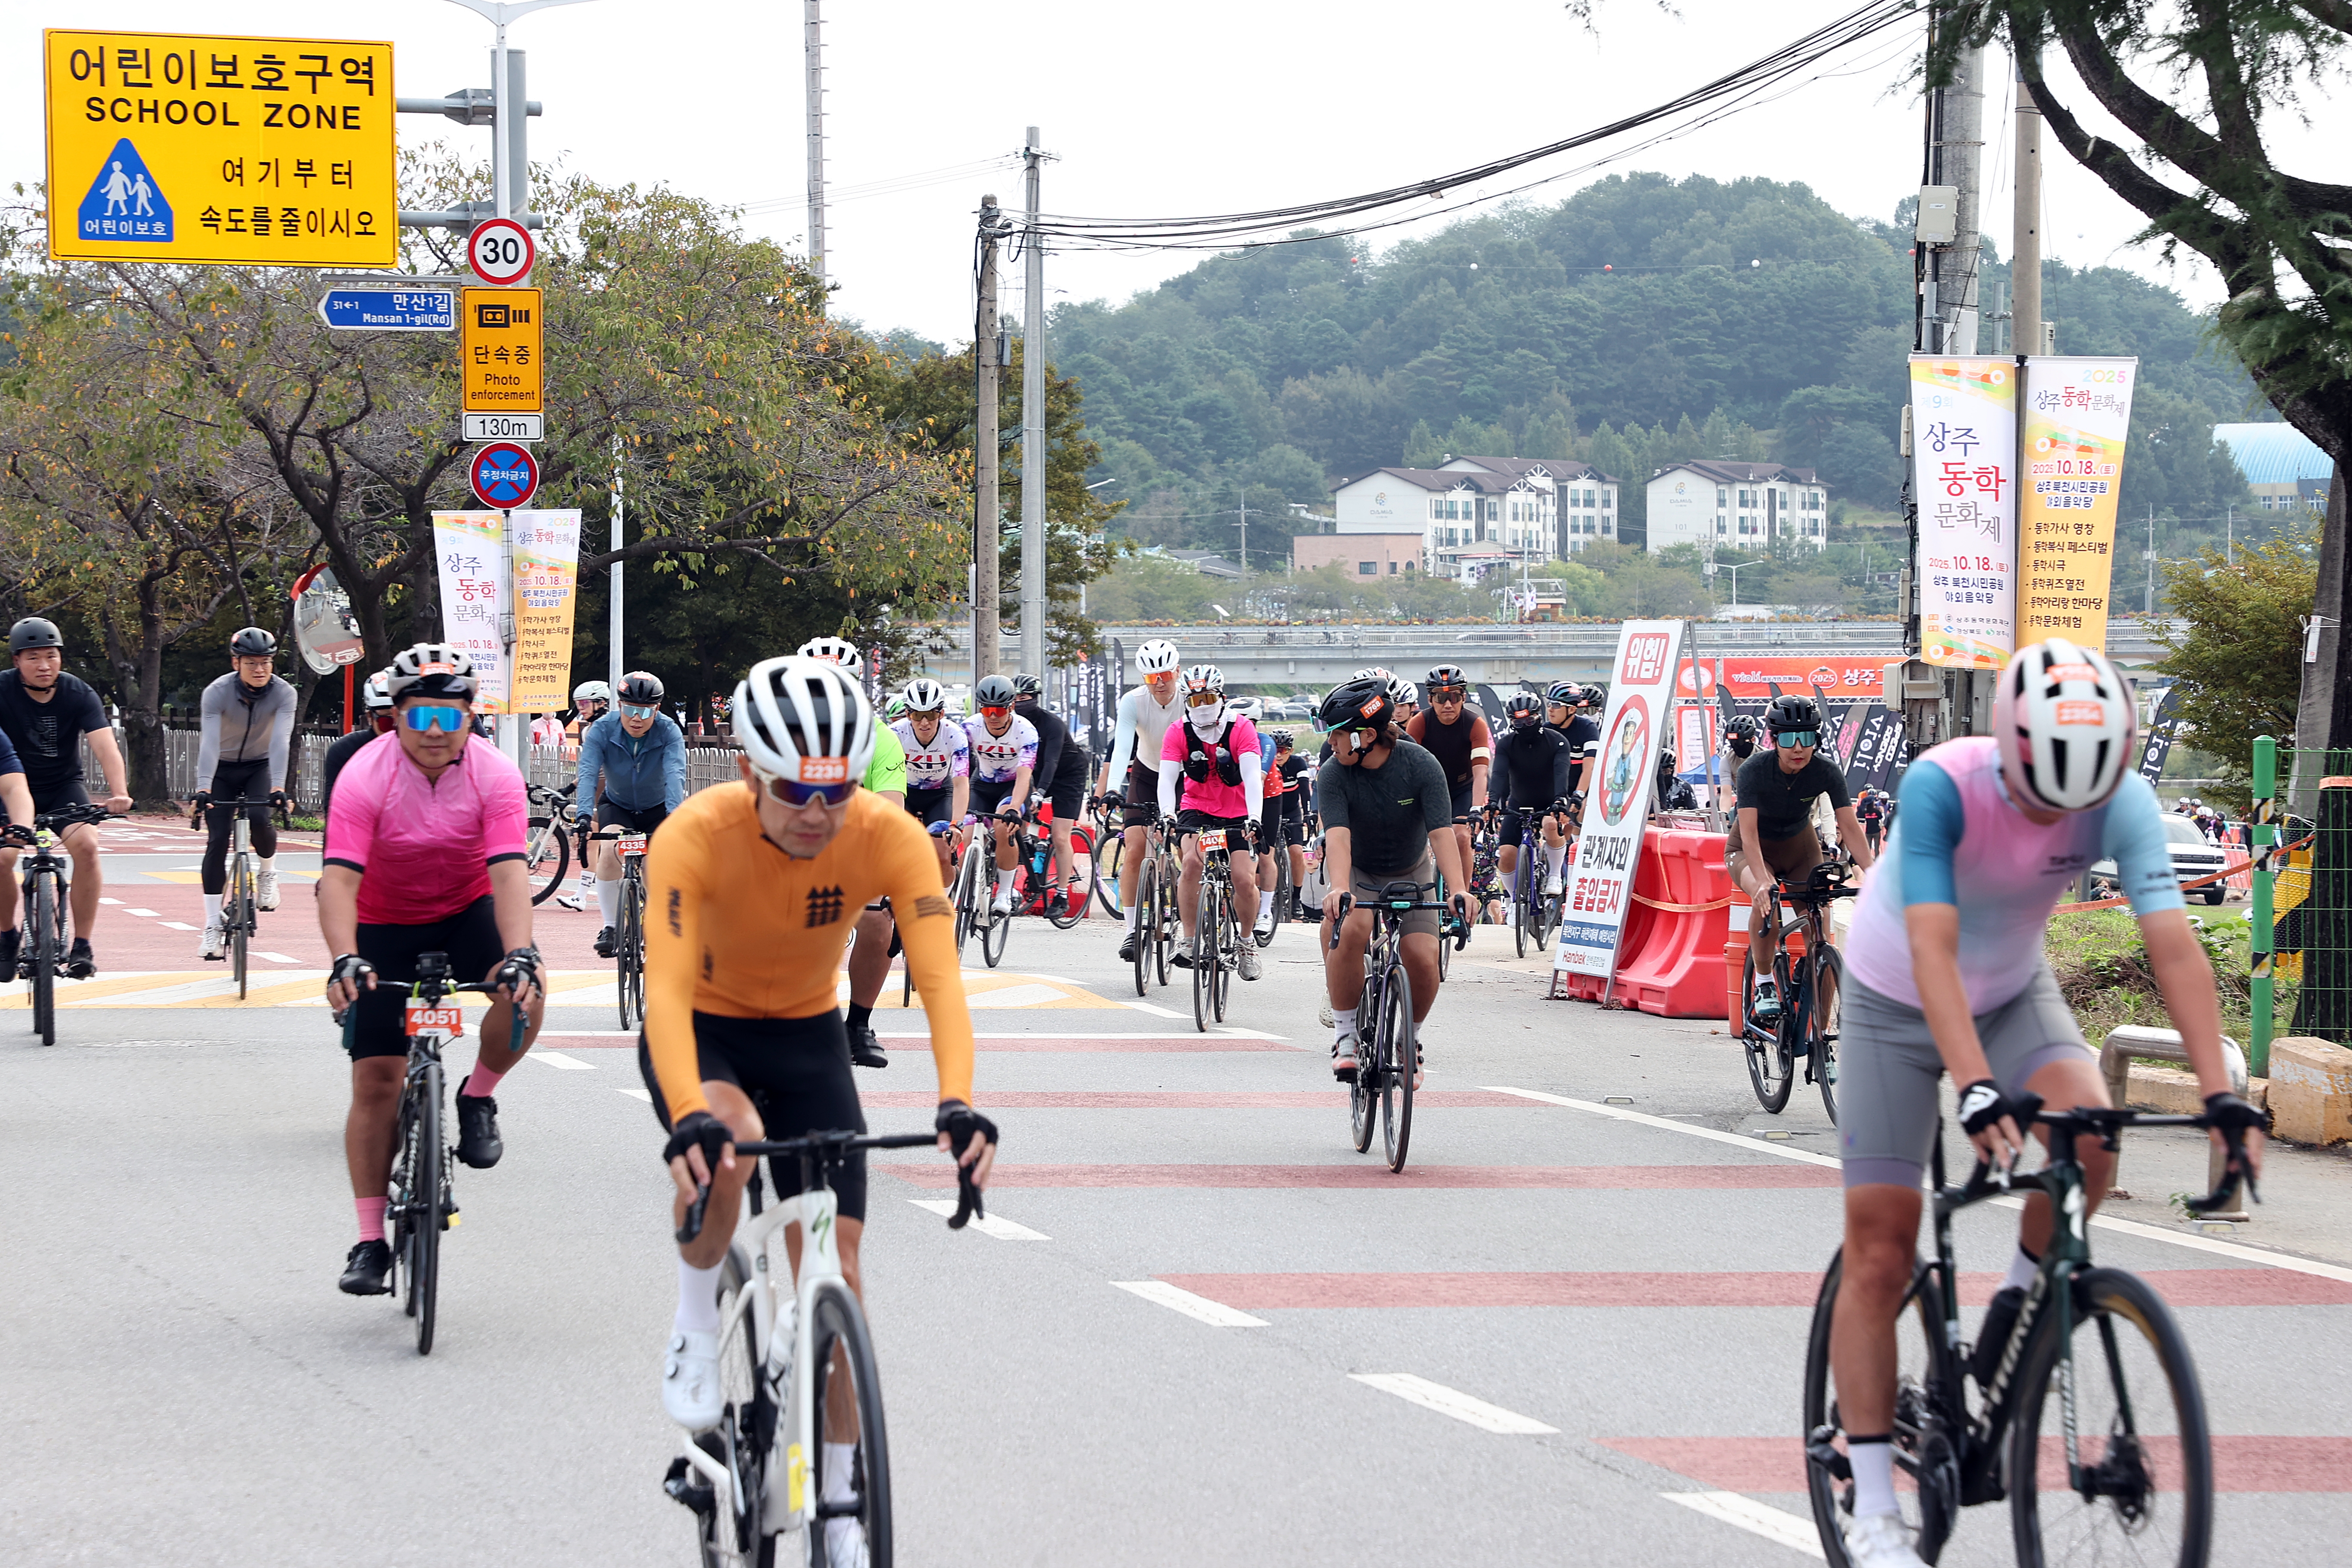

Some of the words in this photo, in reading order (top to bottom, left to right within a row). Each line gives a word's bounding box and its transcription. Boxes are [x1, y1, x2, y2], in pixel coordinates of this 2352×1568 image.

[70, 46, 374, 95] 어린이보호구역
[86, 97, 239, 126] SCHOOL
[264, 103, 361, 130] ZONE
[85, 219, 167, 236] 어린이보호
[482, 238, 519, 264] 30
[393, 294, 449, 312] 만산1길
[363, 313, 403, 324] Mansan
[405, 314, 450, 325] 1-gil(Rd)
[475, 345, 531, 365] 단속중
[484, 373, 521, 386] Photo
[2082, 370, 2126, 383] 2025
[471, 390, 536, 401] enforcement
[1921, 395, 1953, 408] 제9회
[479, 419, 528, 435] 130m
[1923, 422, 1980, 456] 상주
[480, 470, 529, 481] 주정차금지
[2100, 465, 2115, 475] (토)
[1939, 462, 2007, 502] 동학
[2053, 481, 2107, 493] 북천시민공원
[2046, 496, 2093, 508] 야외음악당
[548, 518, 575, 526] 2025
[1934, 501, 2000, 543] 문화제
[2034, 522, 2070, 535] 동학가사
[2073, 523, 2095, 536] 영창
[2034, 541, 2065, 553] 동학복식
[2067, 542, 2108, 554] 페스티벌
[443, 553, 482, 576] 상주
[1996, 562, 2009, 573] (토)
[2032, 560, 2066, 572] 동학시극
[1933, 575, 1949, 587] 상주
[1952, 577, 2004, 591] 북천시민공원
[456, 579, 496, 604] 동학
[533, 588, 568, 597] 북천시민공원
[1945, 591, 1994, 604] 야외음악당
[2030, 597, 2070, 609] 동학아리랑
[2072, 597, 2104, 610] 한마당
[2029, 615, 2082, 628] 동학문화체험
[1626, 637, 1666, 679] 위험!
[1812, 674, 1835, 683] 2025
[1365, 700, 1381, 715] 1768
[620, 841, 645, 850] 4335
[1201, 836, 1225, 846] 1404
[1573, 877, 1623, 914] 출입금지
[1562, 950, 1586, 965] Hanbek
[410, 1010, 458, 1025] 4051
